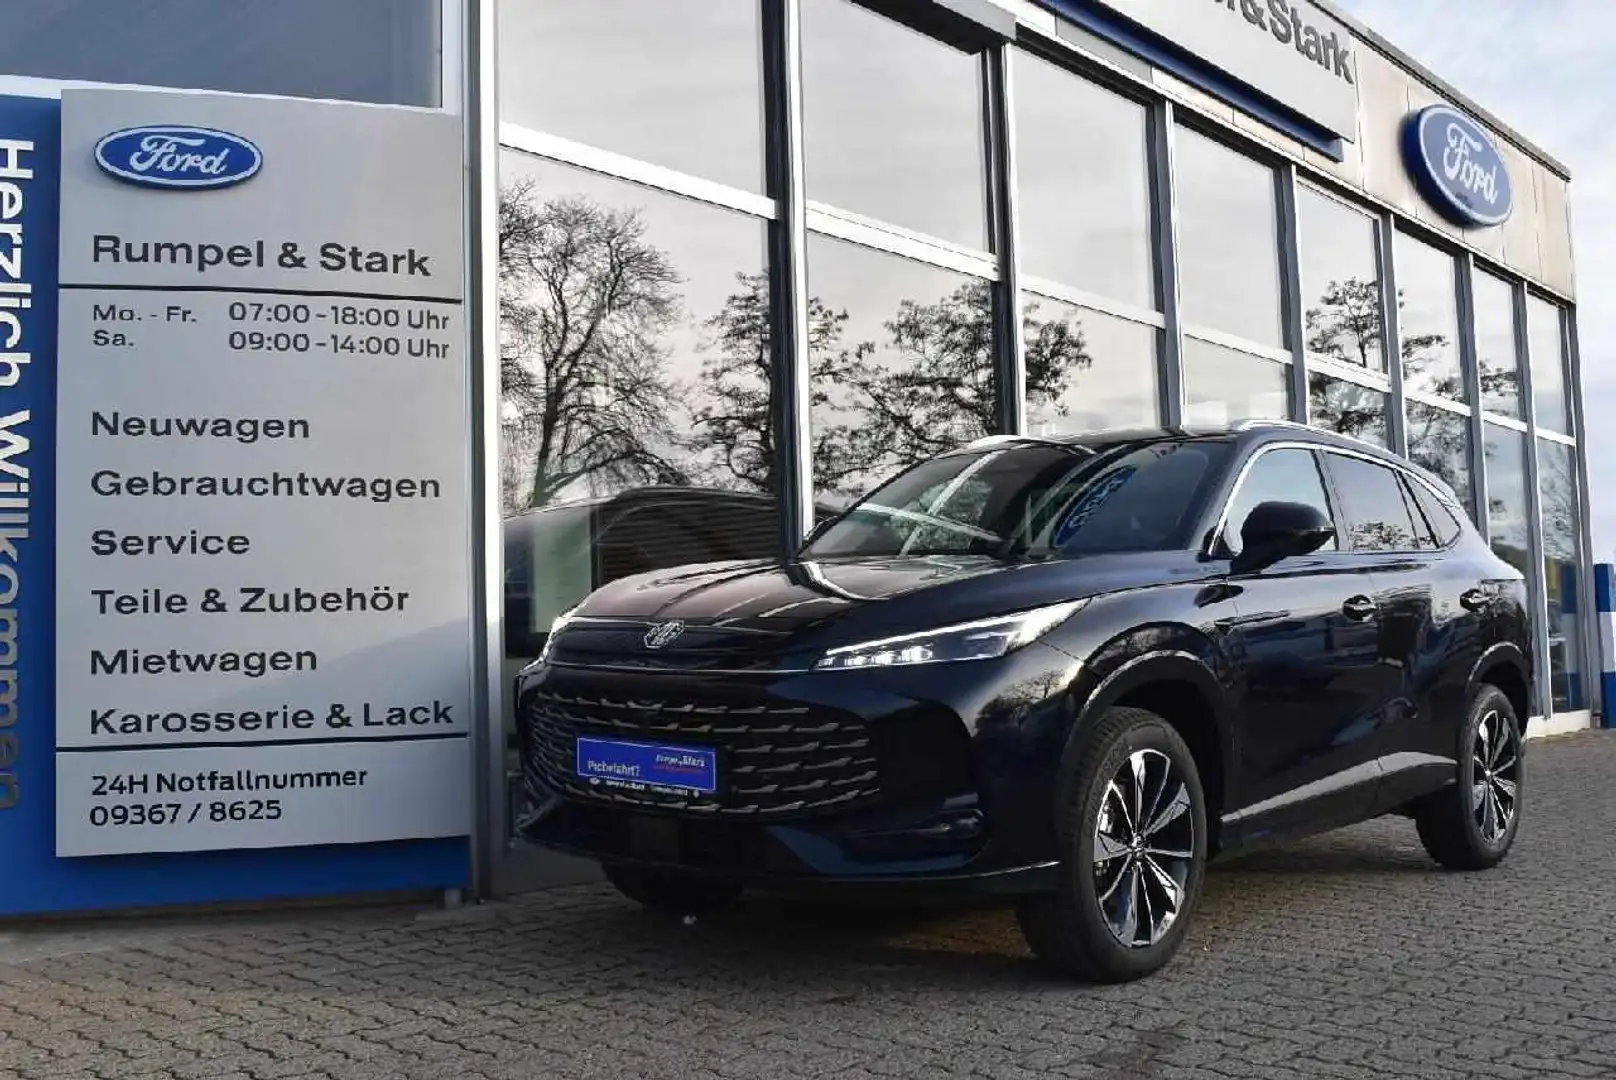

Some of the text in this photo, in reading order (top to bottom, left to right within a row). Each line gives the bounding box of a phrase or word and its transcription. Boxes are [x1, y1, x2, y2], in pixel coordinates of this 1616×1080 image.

[129, 134, 229, 176] Ford
[1443, 122, 1499, 205] Ford
[93, 234, 432, 277] Rumpel & Stark
[93, 303, 143, 322] Mo.
[166, 305, 197, 323] Fr.
[407, 308, 450, 330] Uhr
[92, 329, 135, 347] Sa.
[407, 338, 450, 359] Uhr
[91, 410, 310, 445] Neuwagen
[90, 469, 441, 503] Gebrauchtwagen
[90, 529, 250, 556] Service
[90, 585, 410, 616] Teile & Zubehör
[90, 648, 317, 678] Mietwagen
[90, 699, 454, 735] Karosserie & Lack
[91, 768, 368, 796] 24H Notfallnummer
[89, 803, 182, 827] 09367
[208, 799, 282, 823] 8625
